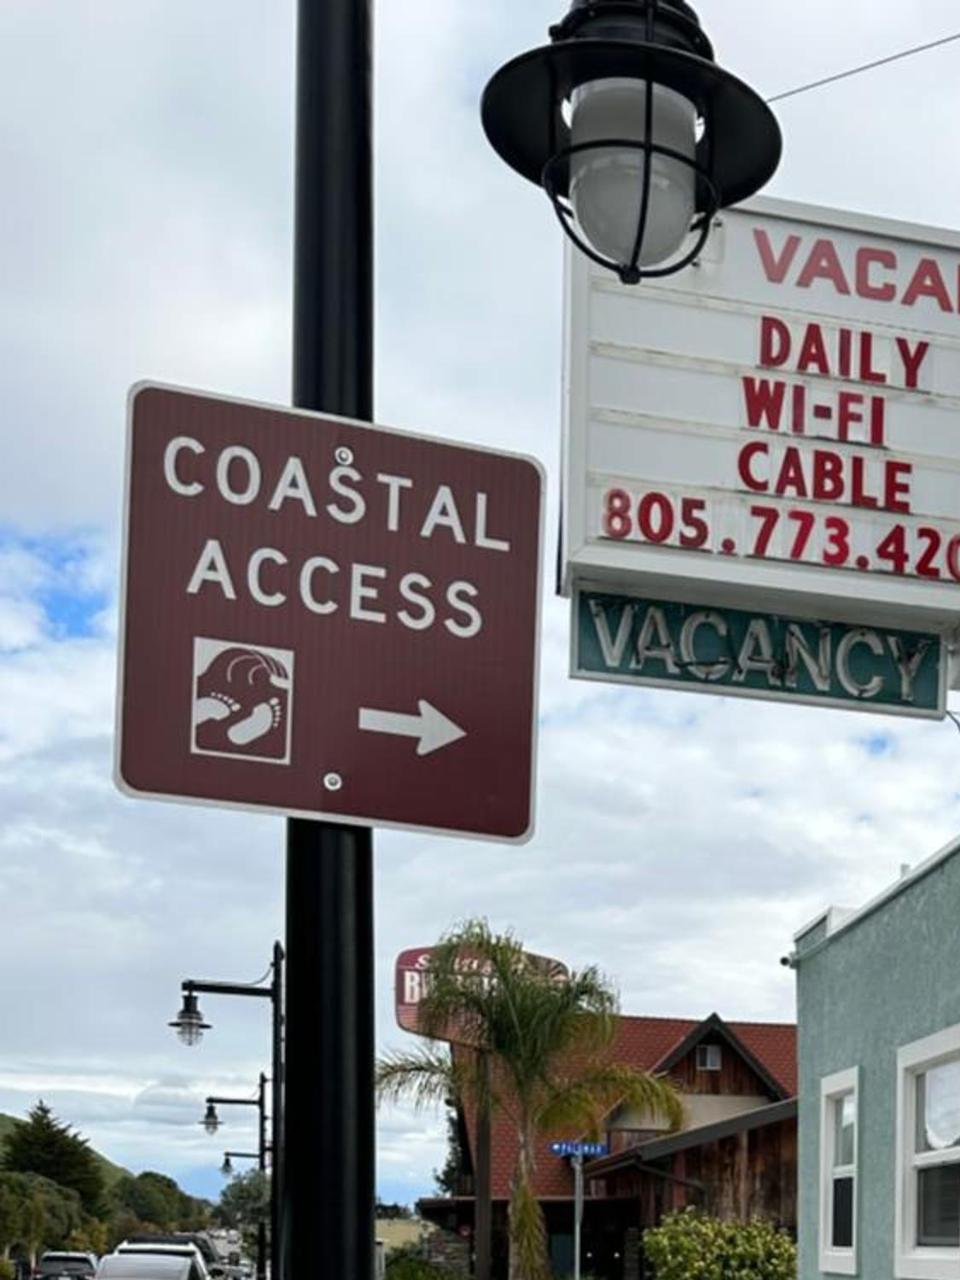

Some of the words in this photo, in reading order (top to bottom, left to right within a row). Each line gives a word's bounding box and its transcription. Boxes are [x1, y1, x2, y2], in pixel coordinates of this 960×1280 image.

[759, 316, 930, 389] DAILY
[742, 376, 886, 445] WI-FI
[163, 435, 511, 552] COASTAL
[737, 441, 913, 514] CABLE
[185, 538, 483, 639] ACCESS
[588, 599, 933, 701] VACANCY
